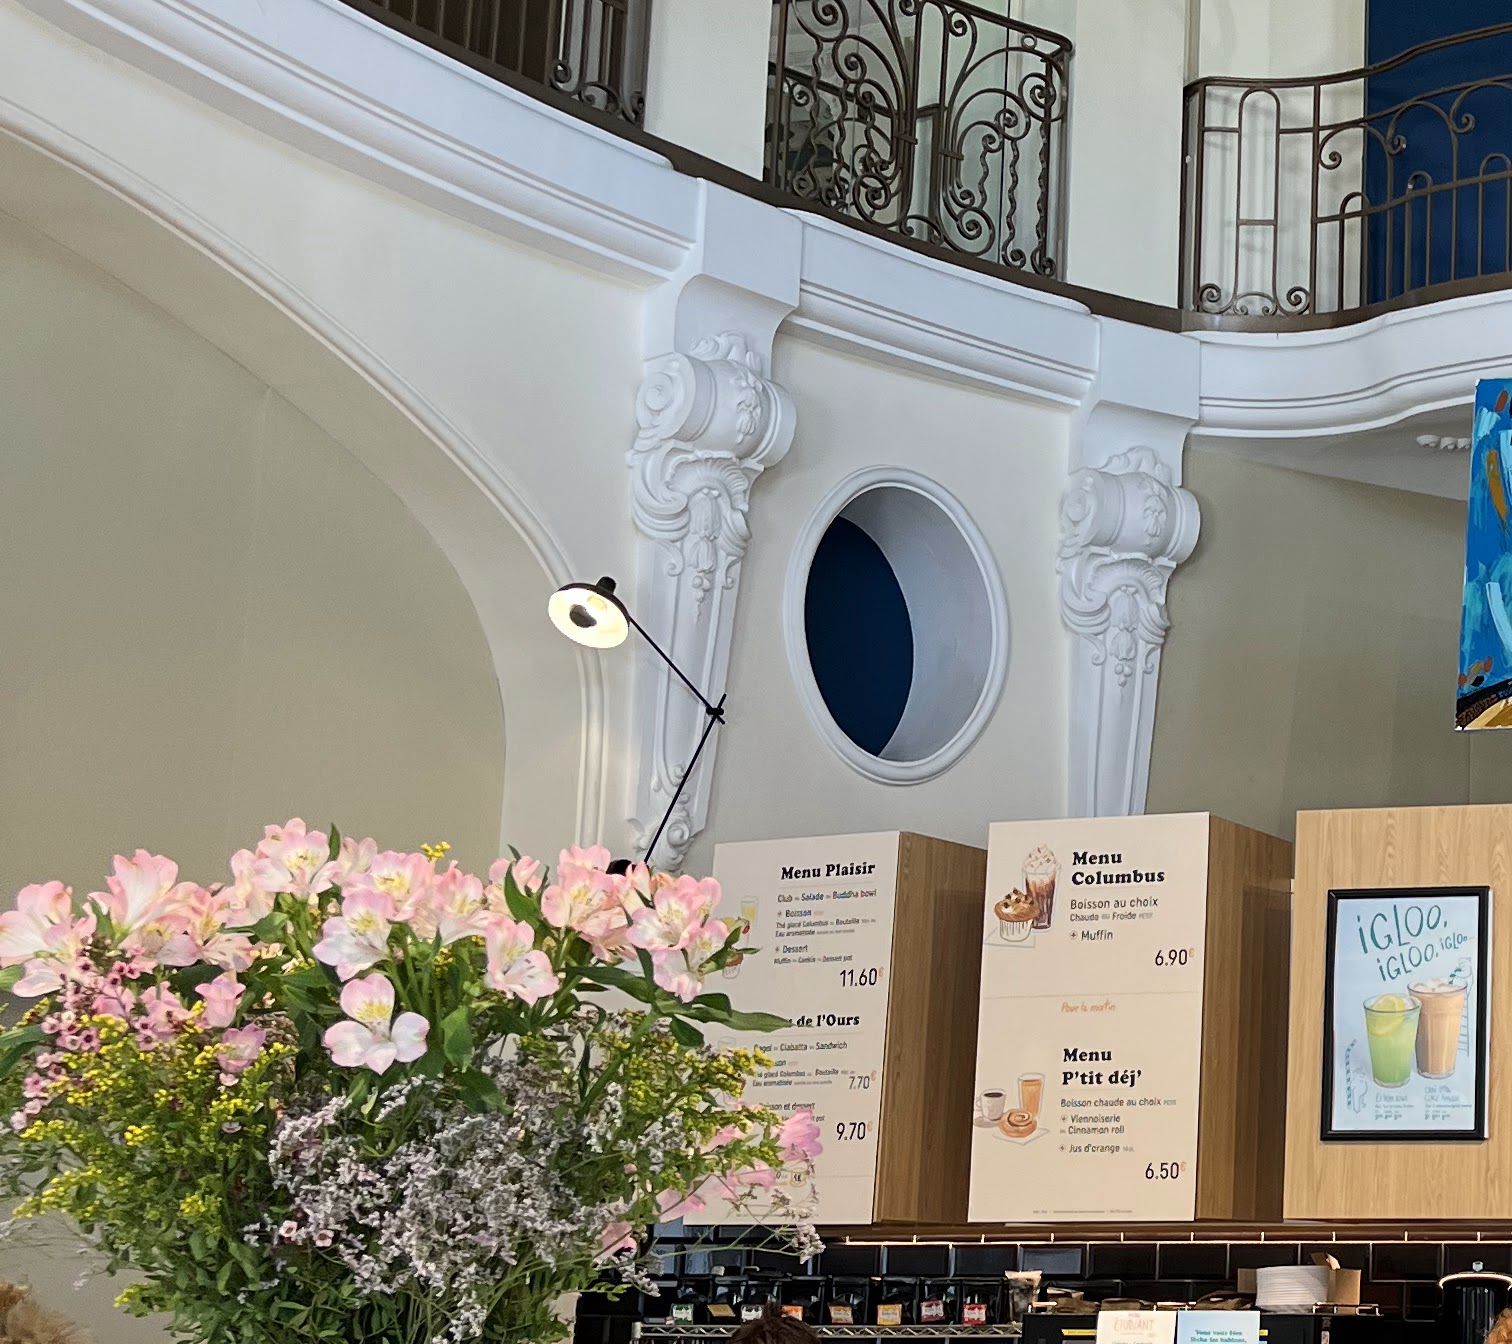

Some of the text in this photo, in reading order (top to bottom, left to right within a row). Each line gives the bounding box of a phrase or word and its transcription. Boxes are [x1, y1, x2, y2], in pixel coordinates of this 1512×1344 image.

[1072, 852, 1122, 865] Menu
[781, 862, 875, 880] Menu Plaisir
[1072, 871, 1165, 885] Columbus
[1070, 897, 1158, 909] Boisson au choix
[1081, 930, 1113, 941] Muffin
[1063, 1049, 1112, 1062] Menu
[1062, 1069, 1141, 1087] P'tit déj'
[1061, 1099, 1091, 1107] Boisson
[1094, 1098, 1124, 1106] chaude
[1071, 1114, 1120, 1123] Viennoiserie
[1069, 1144, 1081, 1153] Jus
